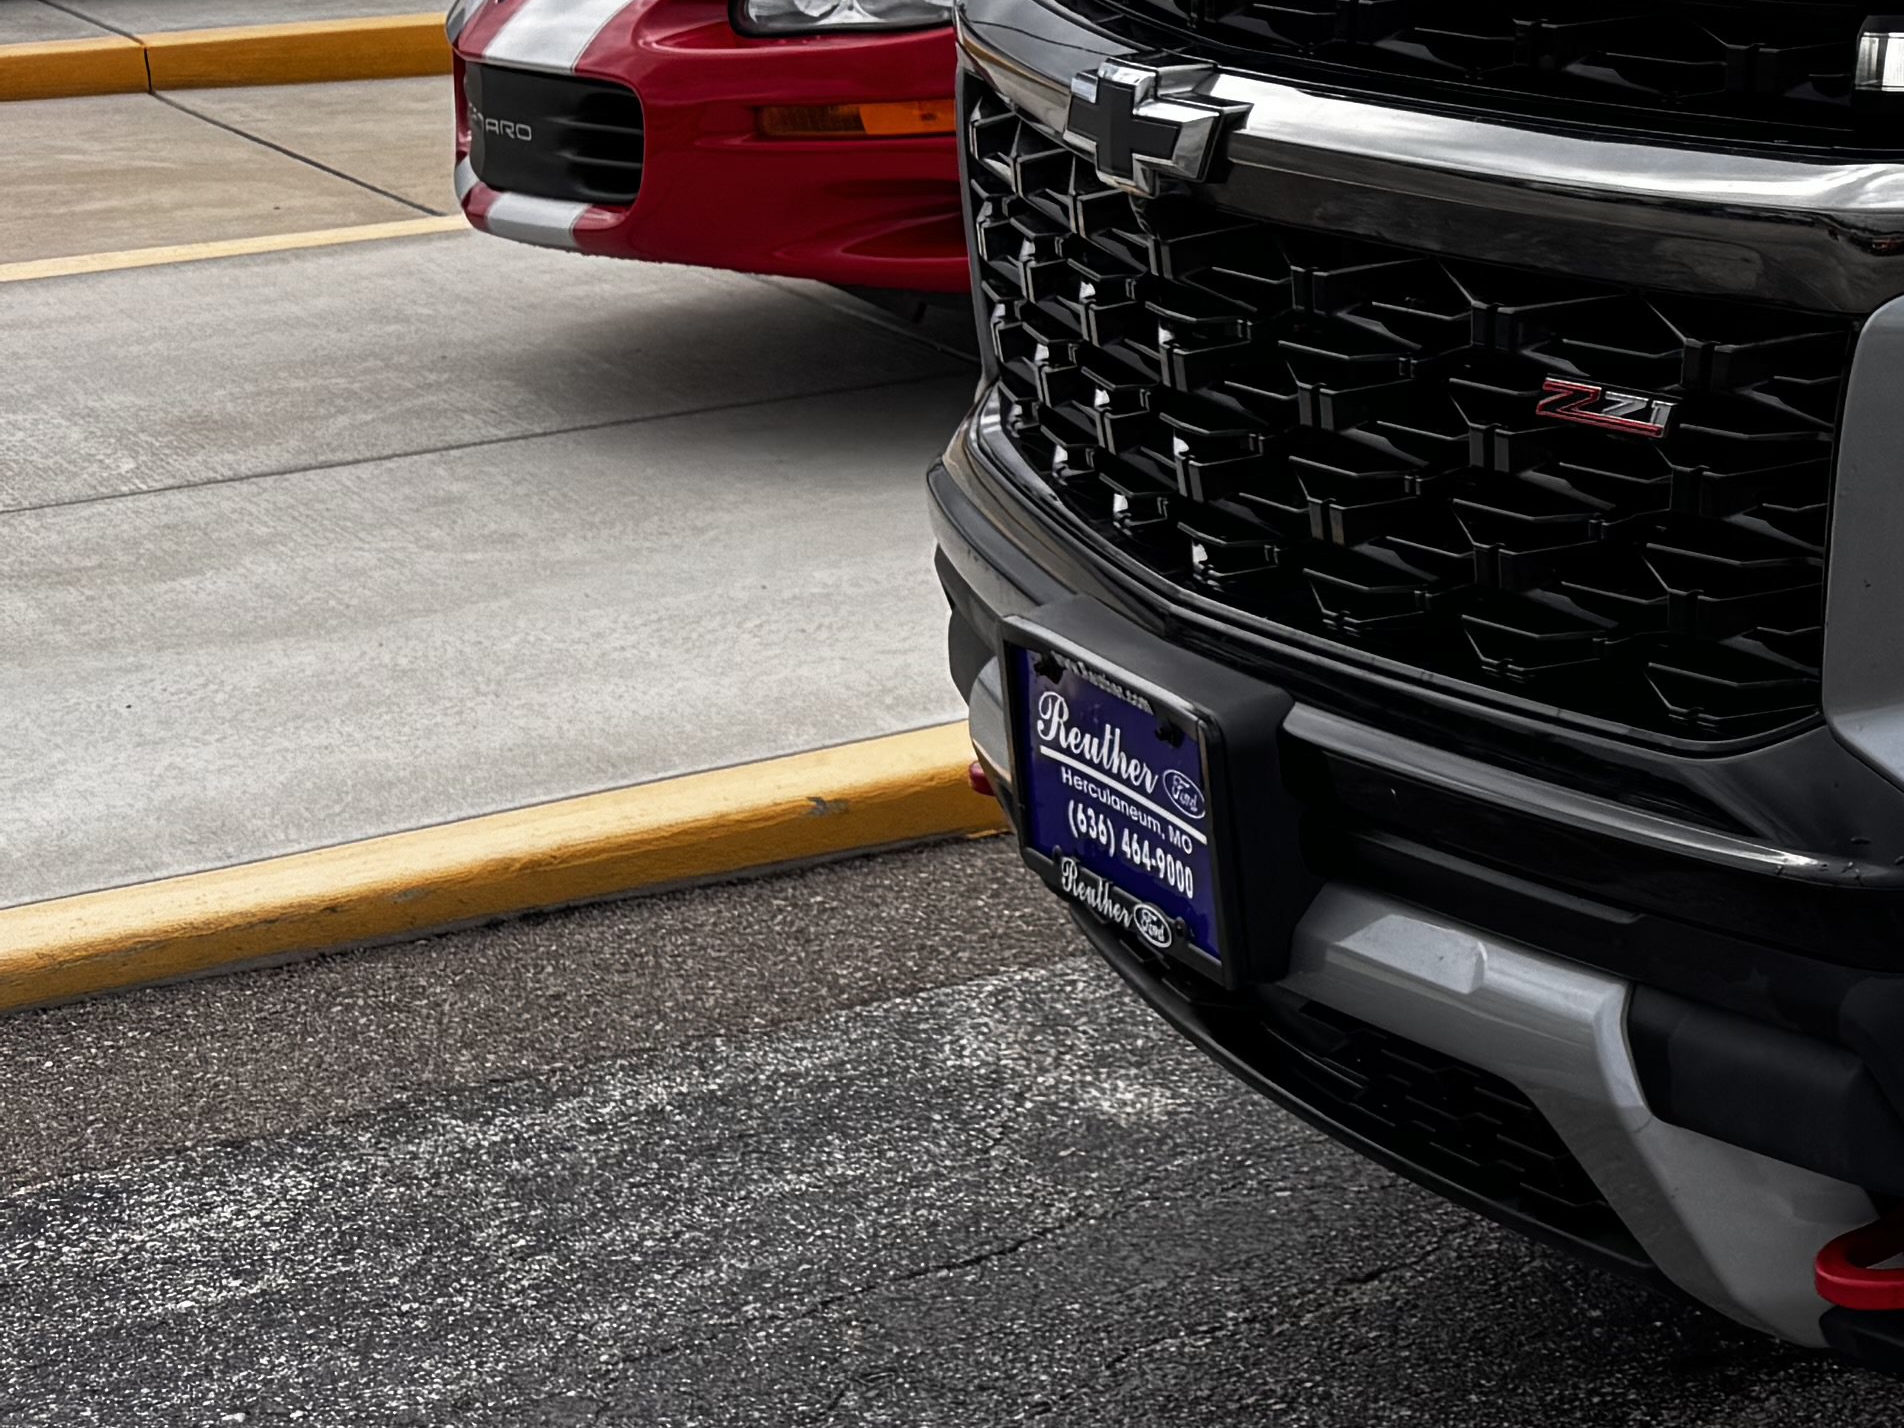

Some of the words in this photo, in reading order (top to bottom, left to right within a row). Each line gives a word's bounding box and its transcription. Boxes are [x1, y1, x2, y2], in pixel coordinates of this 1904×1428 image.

[1535, 376, 1677, 439] Z71
[1036, 690, 1159, 794] Reuther
[1060, 765, 1166, 840] Herculaneum,
[1168, 824, 1193, 856] MO
[1068, 798, 1116, 858] (636)
[1120, 827, 1194, 900] 464-9000
[1061, 856, 1134, 928] Reuther
